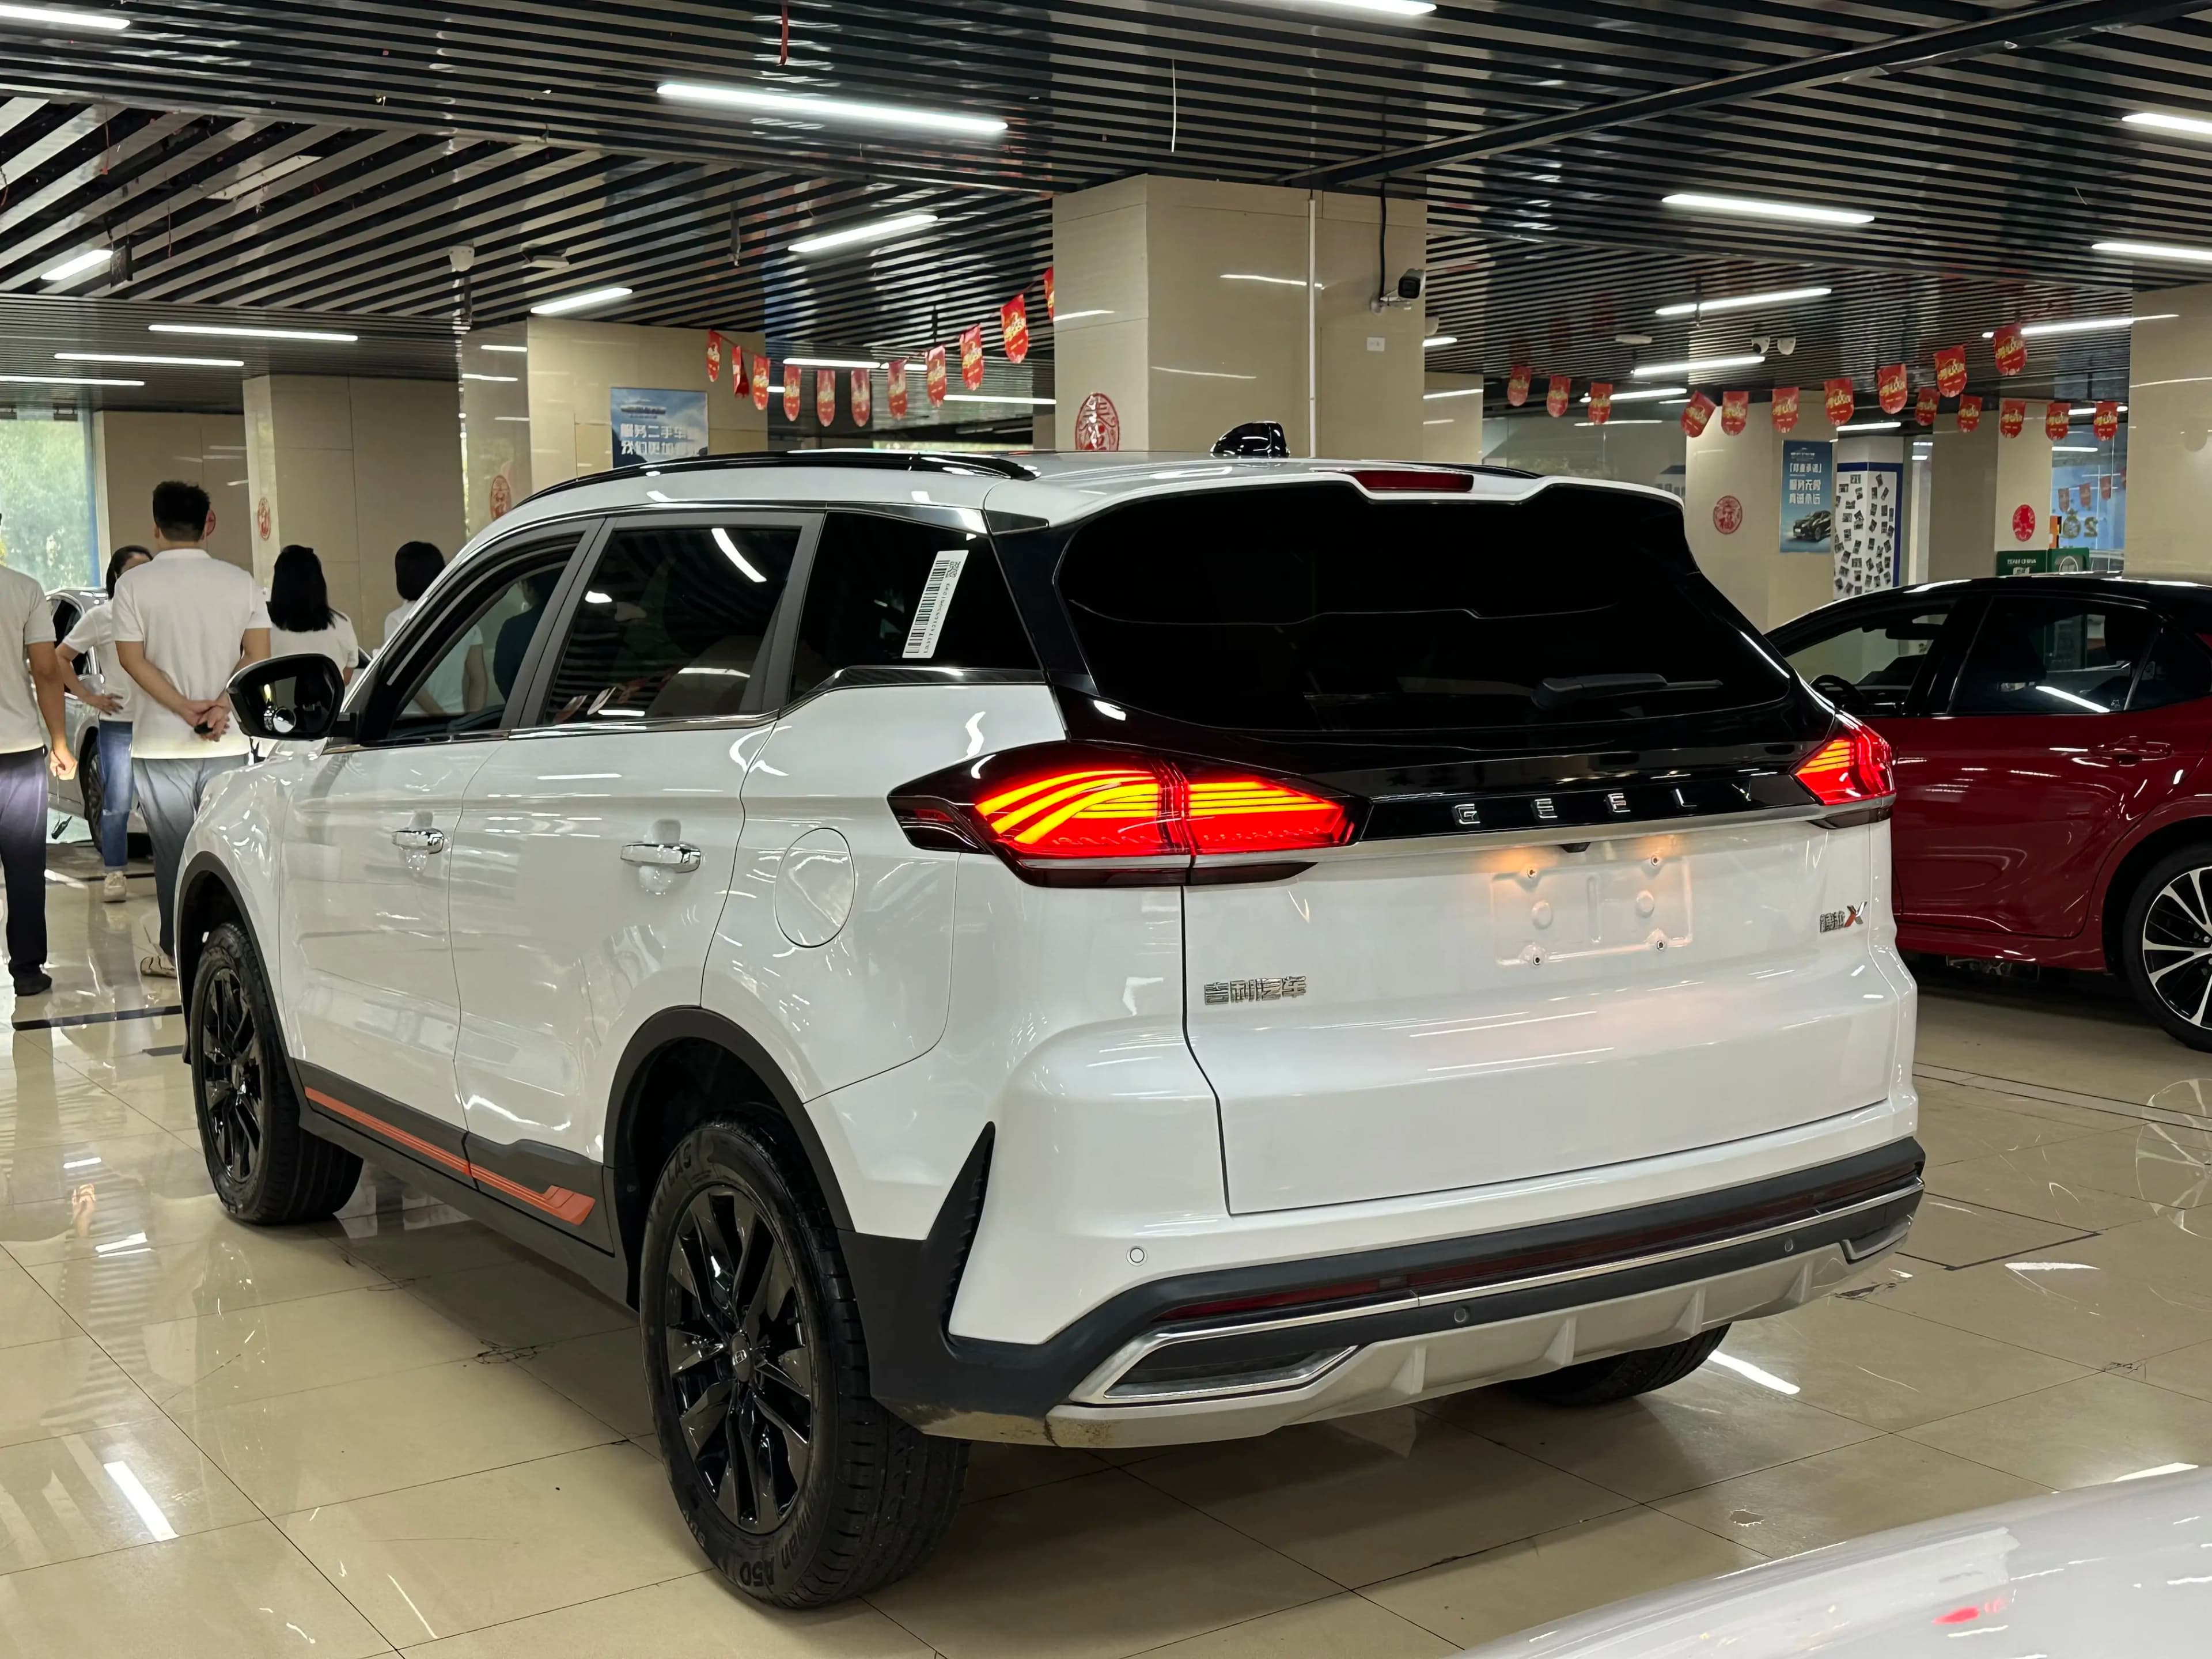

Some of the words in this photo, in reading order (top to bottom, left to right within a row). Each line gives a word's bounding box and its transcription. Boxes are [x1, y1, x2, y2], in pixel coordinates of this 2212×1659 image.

[1452, 780, 1752, 824] GEELY
[1204, 976, 1306, 1005] 吉利汽车
[739, 1557, 775, 1587] A50
